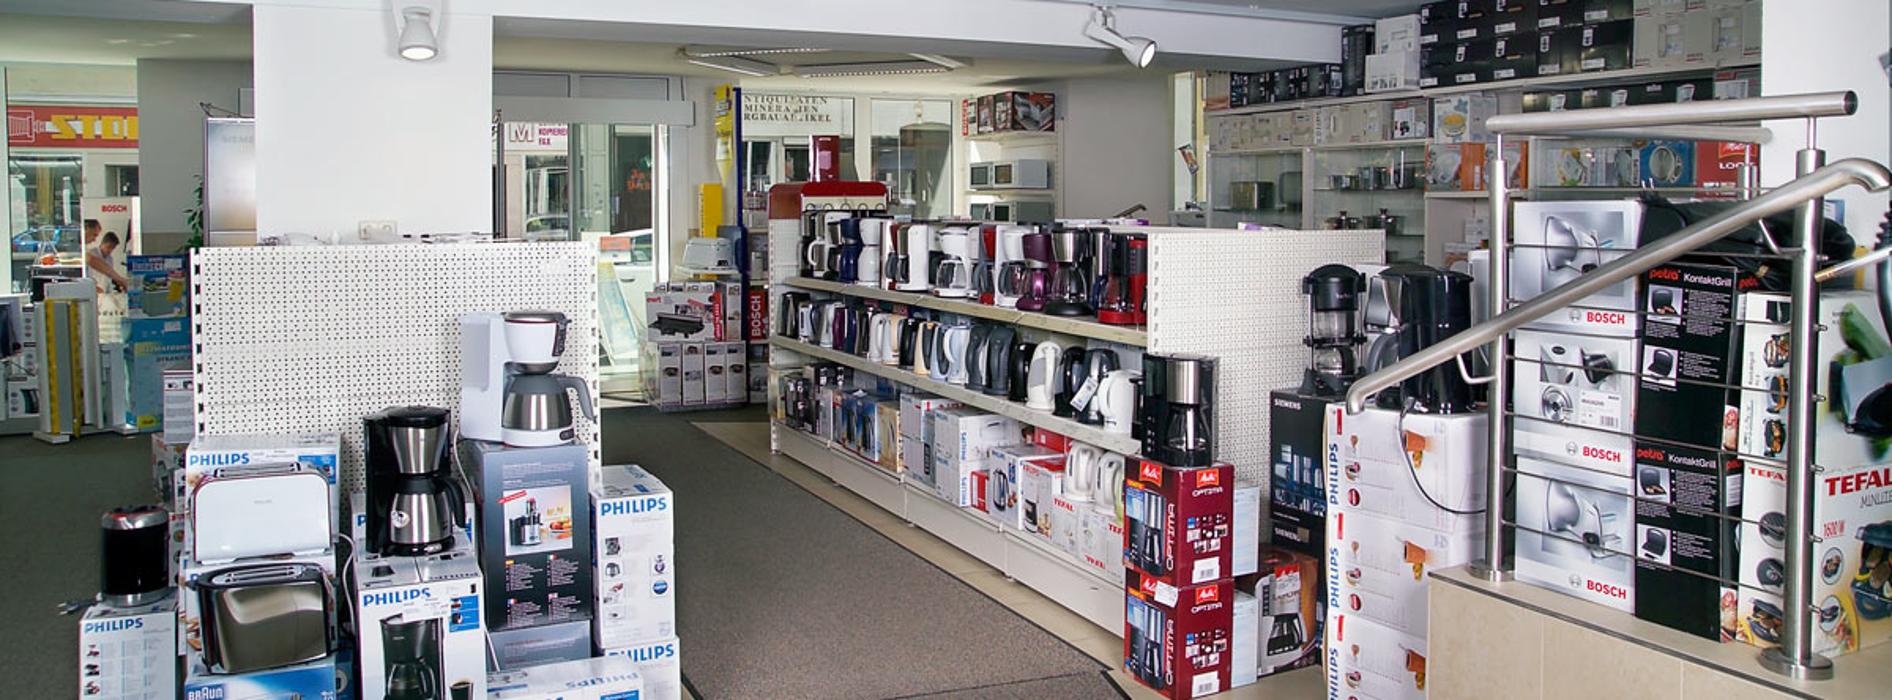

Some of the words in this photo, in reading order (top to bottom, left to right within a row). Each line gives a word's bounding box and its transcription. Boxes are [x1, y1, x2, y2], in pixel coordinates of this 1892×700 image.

[1649, 268, 1679, 281] petra
[1683, 274, 1732, 288] KontaktGrill
[752, 295, 761, 336] BOSCH
[1586, 311, 1625, 325] BOSCH
[189, 453, 250, 466] PHILIPS
[1582, 446, 1621, 462] BOSCH
[1636, 448, 1664, 461] petra
[1667, 454, 1717, 470] KontaktGrill
[1329, 443, 1339, 505] PHILIPS
[1824, 467, 1892, 497] TEFAL
[1191, 486, 1223, 498] OPTIMA
[600, 497, 667, 517] PHILIPS
[1166, 503, 1176, 572] OPTIMA
[1331, 547, 1340, 608] PHILIPS
[363, 587, 430, 607] PHILIPS
[1586, 578, 1627, 600] BOSCH
[1190, 601, 1223, 614] OPTIMA
[85, 618, 143, 633] PHILIPS
[1166, 618, 1175, 686] OPTIMA
